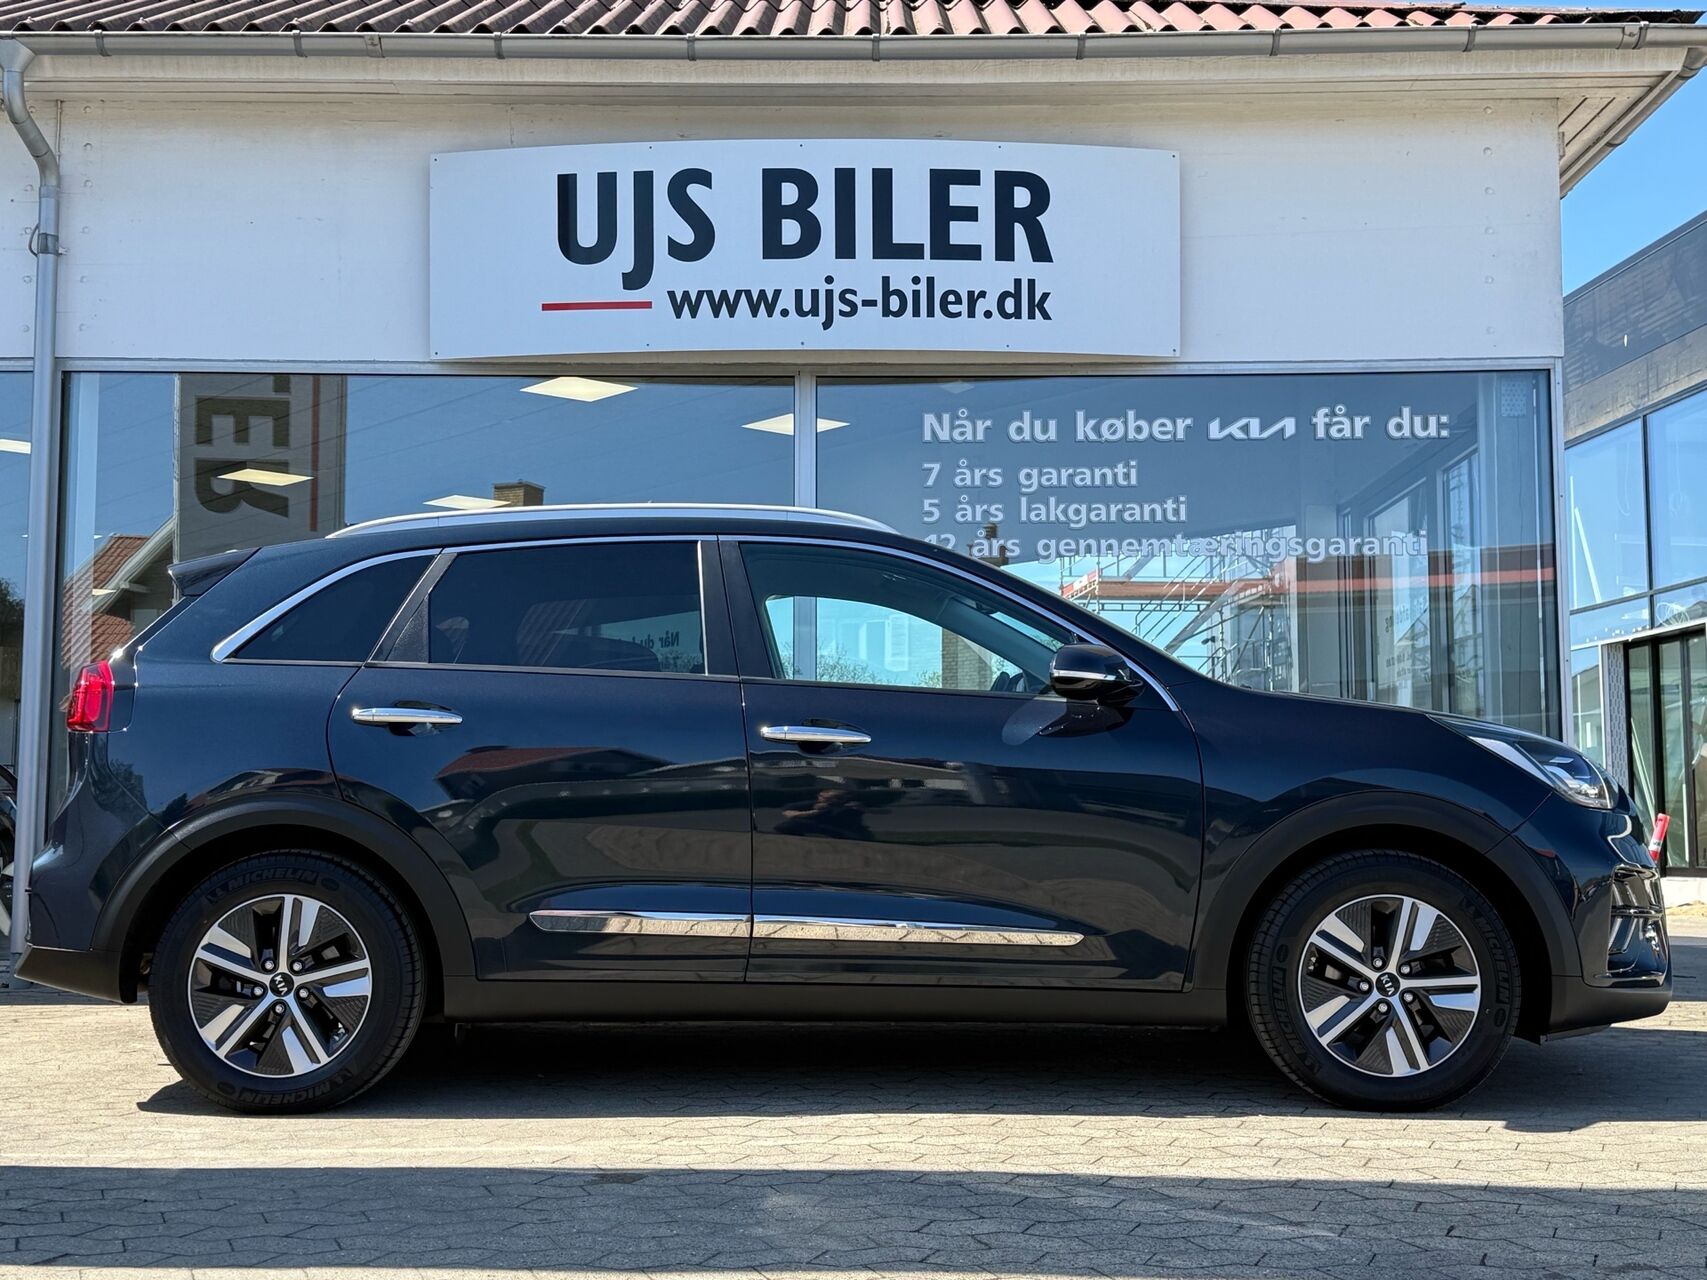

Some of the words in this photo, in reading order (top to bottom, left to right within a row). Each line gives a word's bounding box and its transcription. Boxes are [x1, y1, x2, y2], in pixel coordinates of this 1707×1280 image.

[555, 168, 716, 290] UJS
[761, 167, 1055, 263] BILER
[667, 275, 1052, 330] www.ujs-biler.dk
[922, 408, 992, 442] Når
[1007, 410, 1057, 442] du
[1074, 409, 1193, 443] køber
[1311, 404, 1371, 440] får
[1386, 406, 1450, 440] du:
[922, 462, 942, 488] 7
[953, 458, 1003, 488] års
[1017, 459, 1139, 494] garanti
[922, 498, 942, 524] 5
[954, 494, 1004, 524] års
[1018, 495, 1189, 530] lakgaranti
[972, 528, 1021, 558] års
[1036, 529, 1429, 564] gennemtæringsgaranti
